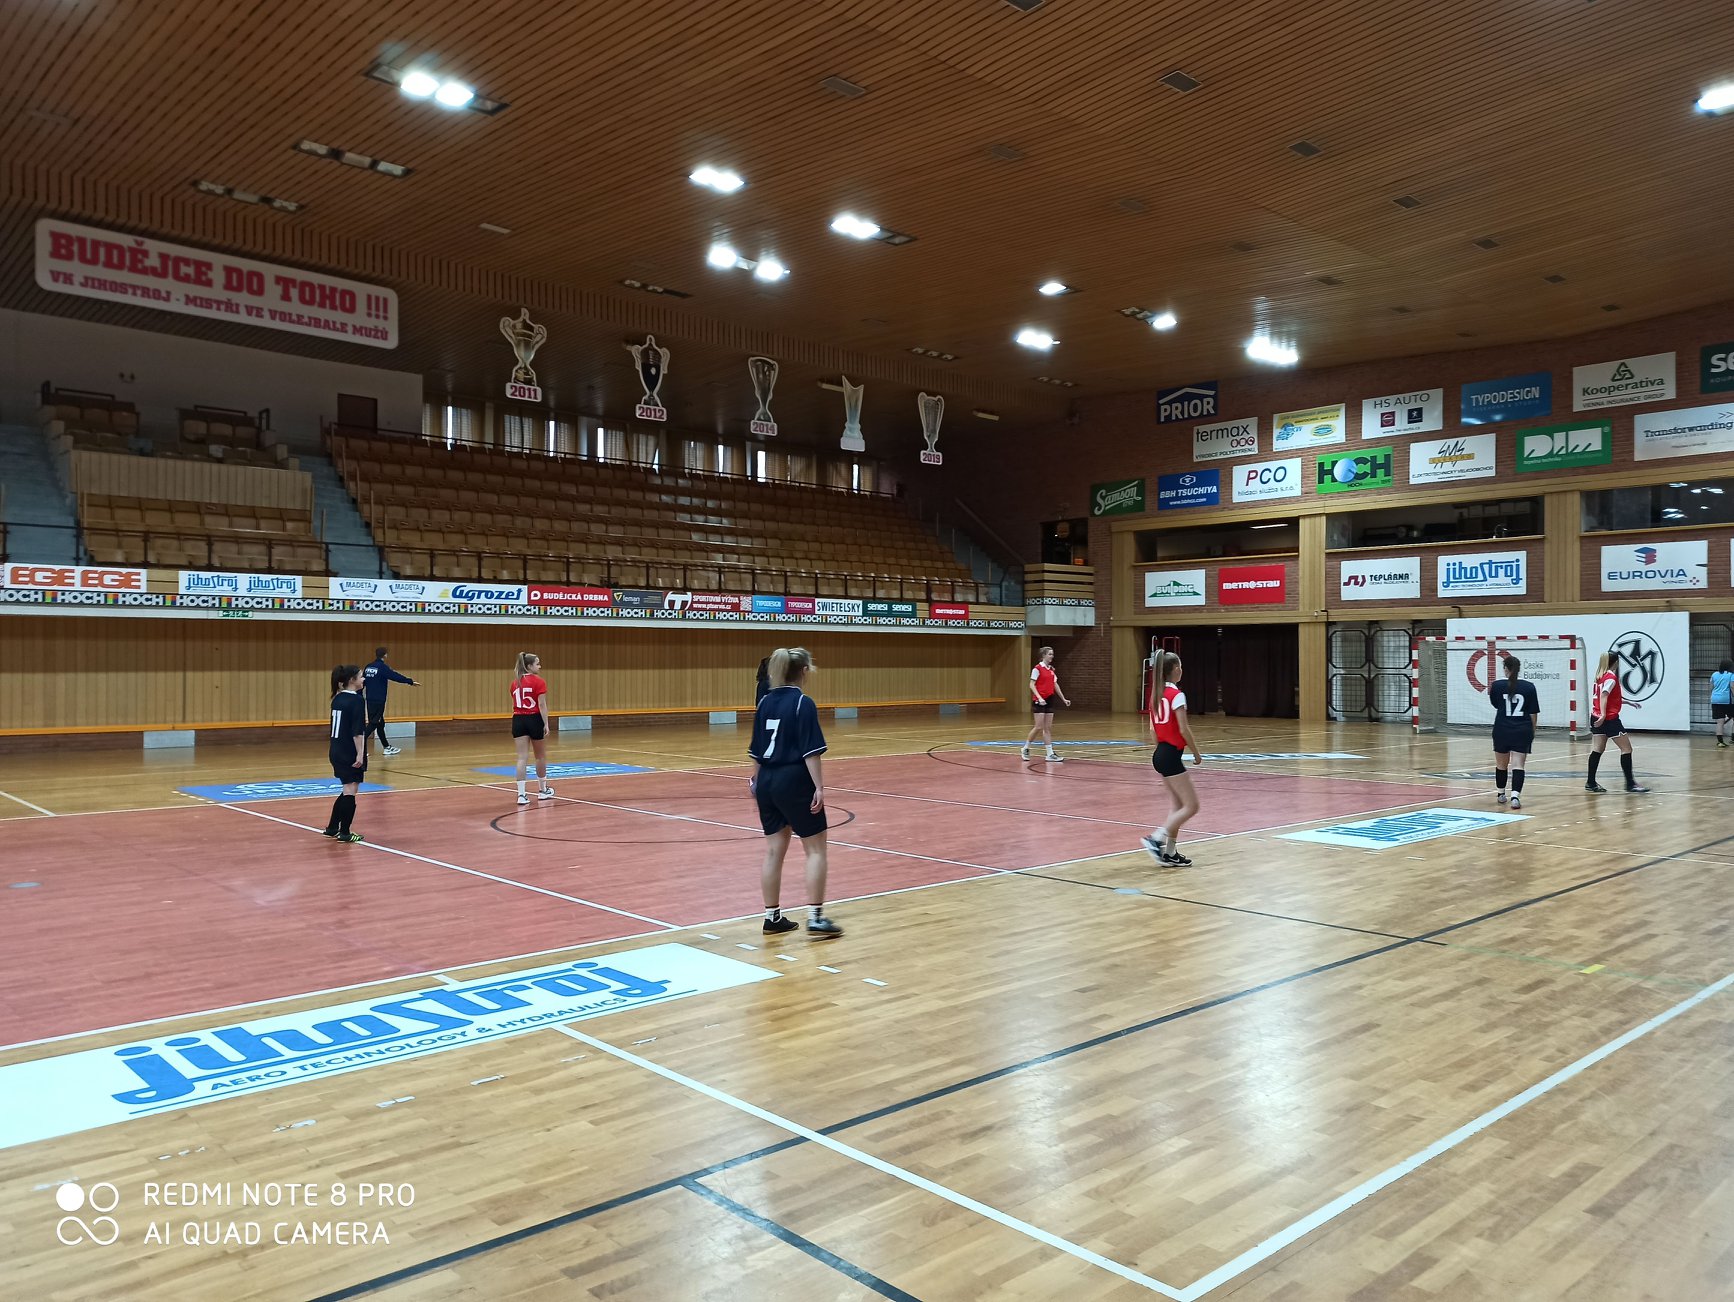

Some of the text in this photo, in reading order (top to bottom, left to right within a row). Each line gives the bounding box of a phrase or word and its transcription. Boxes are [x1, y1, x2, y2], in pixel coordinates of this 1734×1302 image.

[48, 230, 389, 321] BUDĚJCE DO TOHO !!!
[49, 270, 74, 286] VK
[79, 274, 172, 303] JIHOSTROJ
[184, 294, 240, 314] MISTŘI
[244, 304, 264, 319] VE
[268, 307, 348, 333] VOLEJBALE
[352, 322, 389, 341] MUŽŮ
[510, 385, 538, 400] 2011
[1470, 386, 1540, 406] TYPODESIGN
[1582, 377, 1665, 396] Kooperativa
[1160, 397, 1215, 422] PRIOR
[1374, 392, 1430, 409] HS AUTO
[638, 407, 664, 420] 2012
[752, 422, 776, 434] 2014
[1196, 424, 1250, 442] termax
[1643, 422, 1734, 438] Transforwarding
[1245, 466, 1286, 486] PCO
[1094, 487, 1142, 515] Samson
[1160, 485, 1218, 498] BBH TSUCHIYA
[10, 566, 75, 586] EGE
[80, 570, 141, 589] EGE
[1369, 572, 1410, 581] TEPLÁRNA
[1442, 558, 1522, 588] jihostroj
[1608, 569, 1688, 580] EUROVIA
[186, 574, 297, 594] jihostroj jihostroj
[1156, 581, 1194, 596] BUILDING
[57, 591, 104, 604] HOCH
[118, 592, 163, 606] HOCH
[176, 596, 219, 608] HOCH
[232, 597, 272, 608] HOCH
[284, 599, 323, 609] HOCH
[426, 603, 458, 613] HOCH
[468, 604, 499, 614] HOCH
[509, 605, 538, 614] HOCH
[547, 606, 576, 616] HOCH
[584, 607, 611, 616] HOCH
[619, 608, 644, 617] HOCH
[654, 609, 678, 618] HOCH
[686, 611, 709, 619] HOCH
[716, 612, 739, 620] HOCH
[817, 602, 861, 613] SWIETELSKY
[512, 686, 536, 710] 15
[1503, 693, 1524, 717] 12
[331, 709, 342, 739] 11
[762, 718, 781, 759] 7
[111, 962, 670, 1105] jihostroj
[210, 1070, 287, 1090] AERO
[293, 1031, 468, 1071] TECHNOLOGY
[496, 998, 628, 1028] HYDRAULICS
